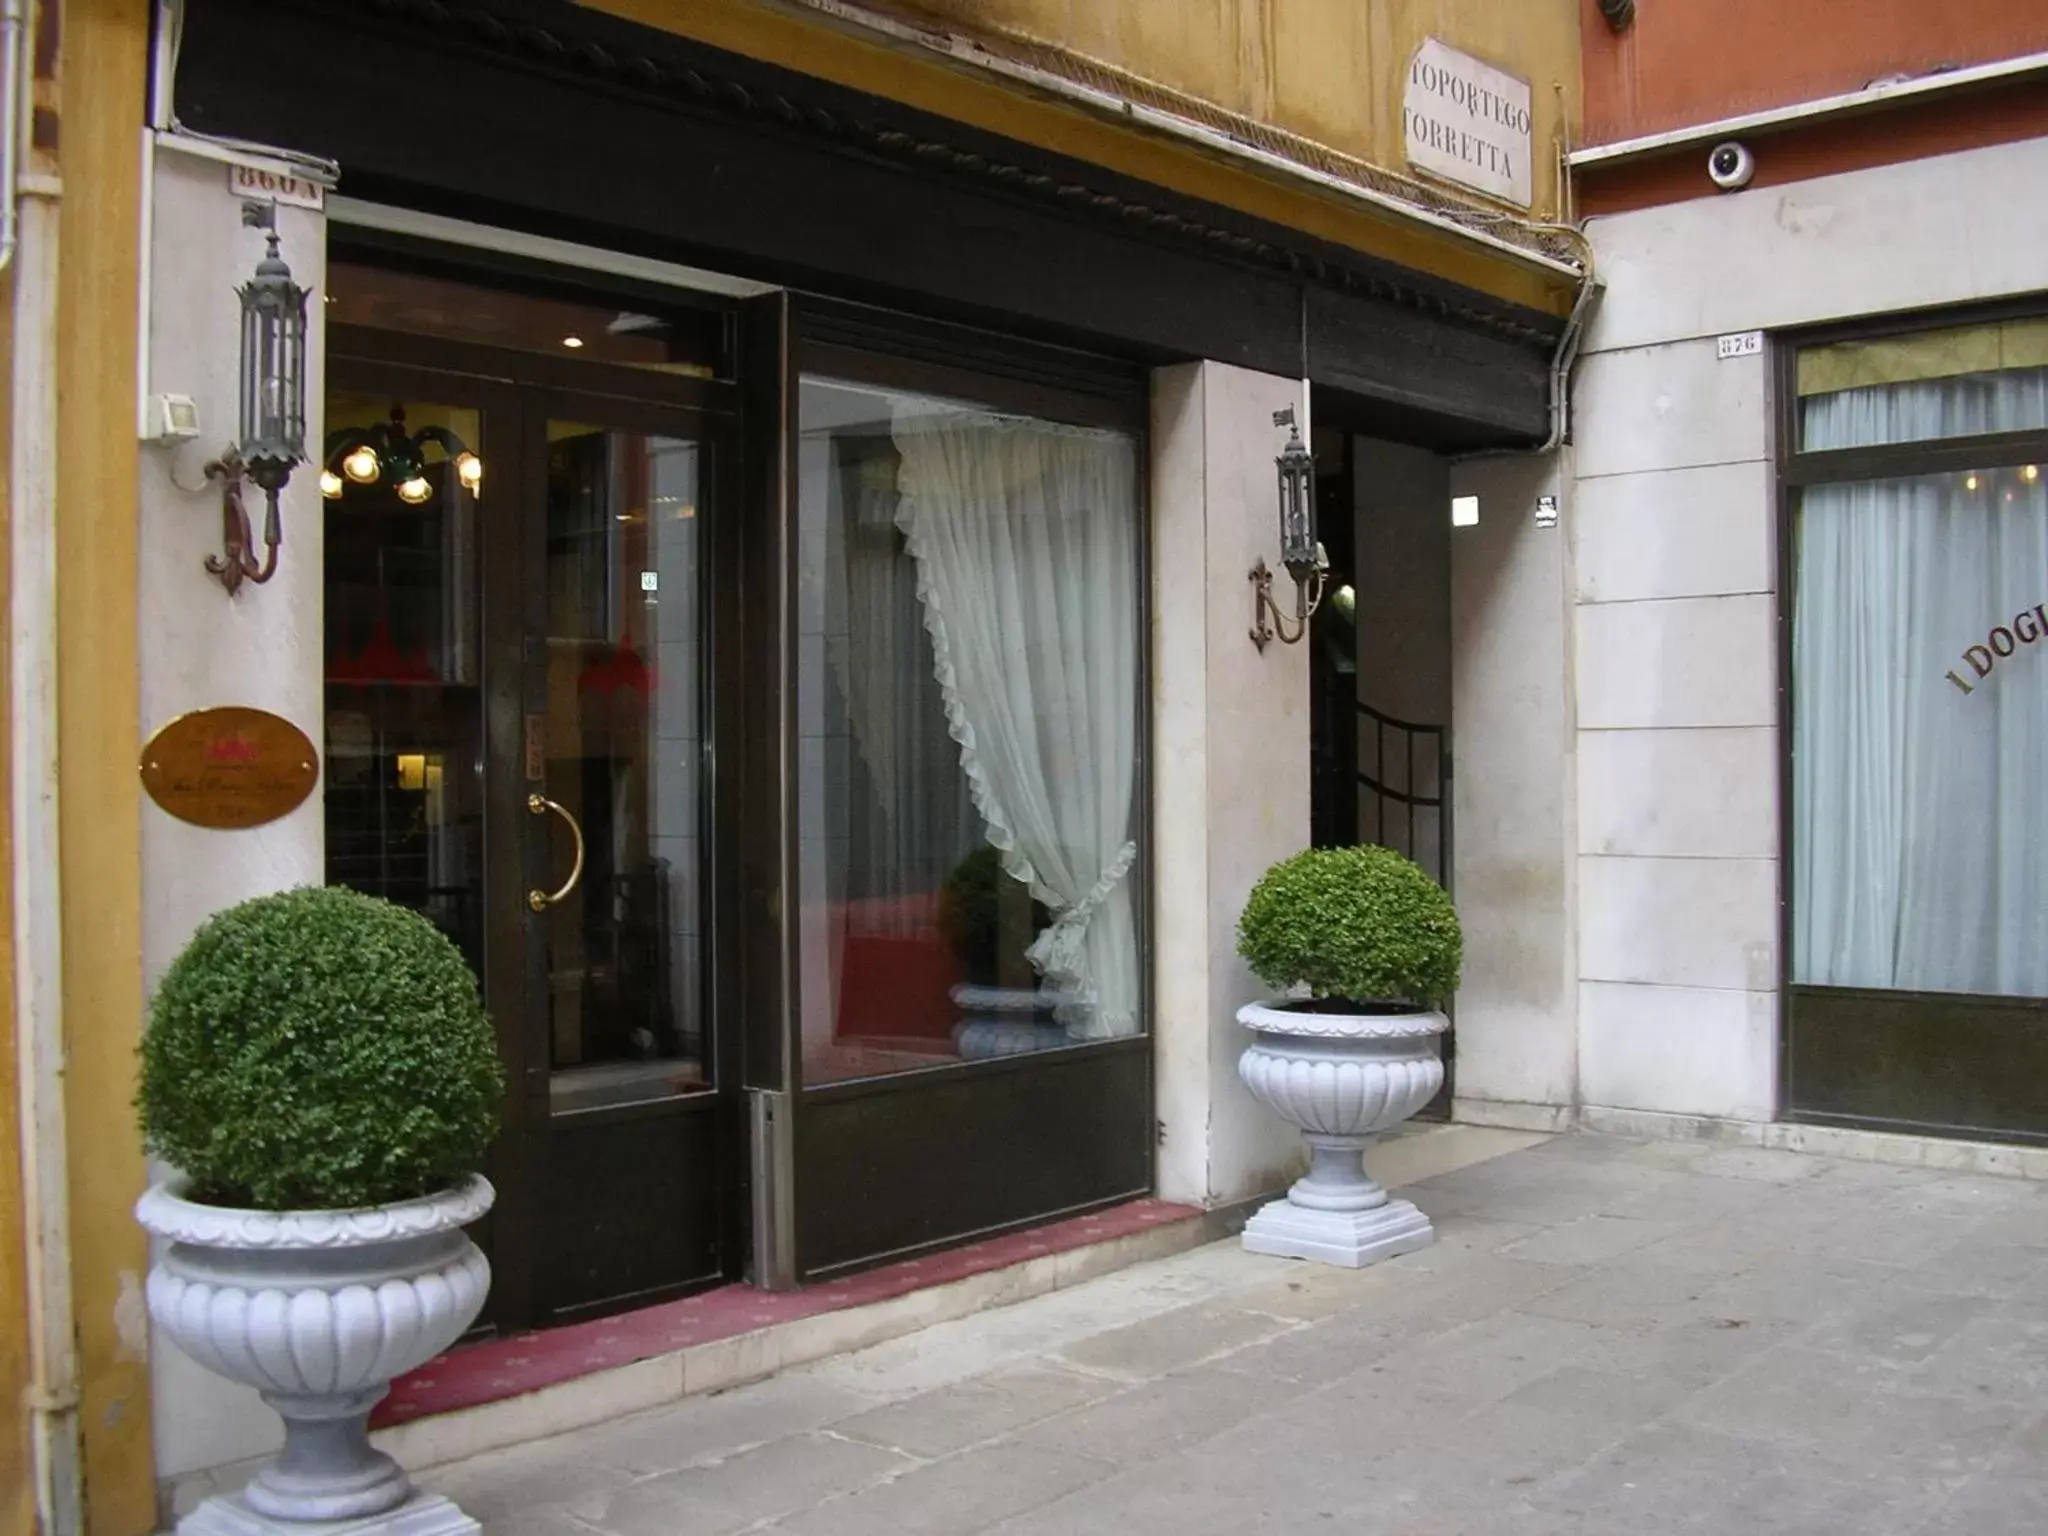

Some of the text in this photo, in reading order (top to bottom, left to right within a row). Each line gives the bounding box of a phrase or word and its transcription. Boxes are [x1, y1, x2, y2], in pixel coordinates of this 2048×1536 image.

[1721, 336, 1755, 353] 876
[1944, 603, 2048, 695] I DOGI
